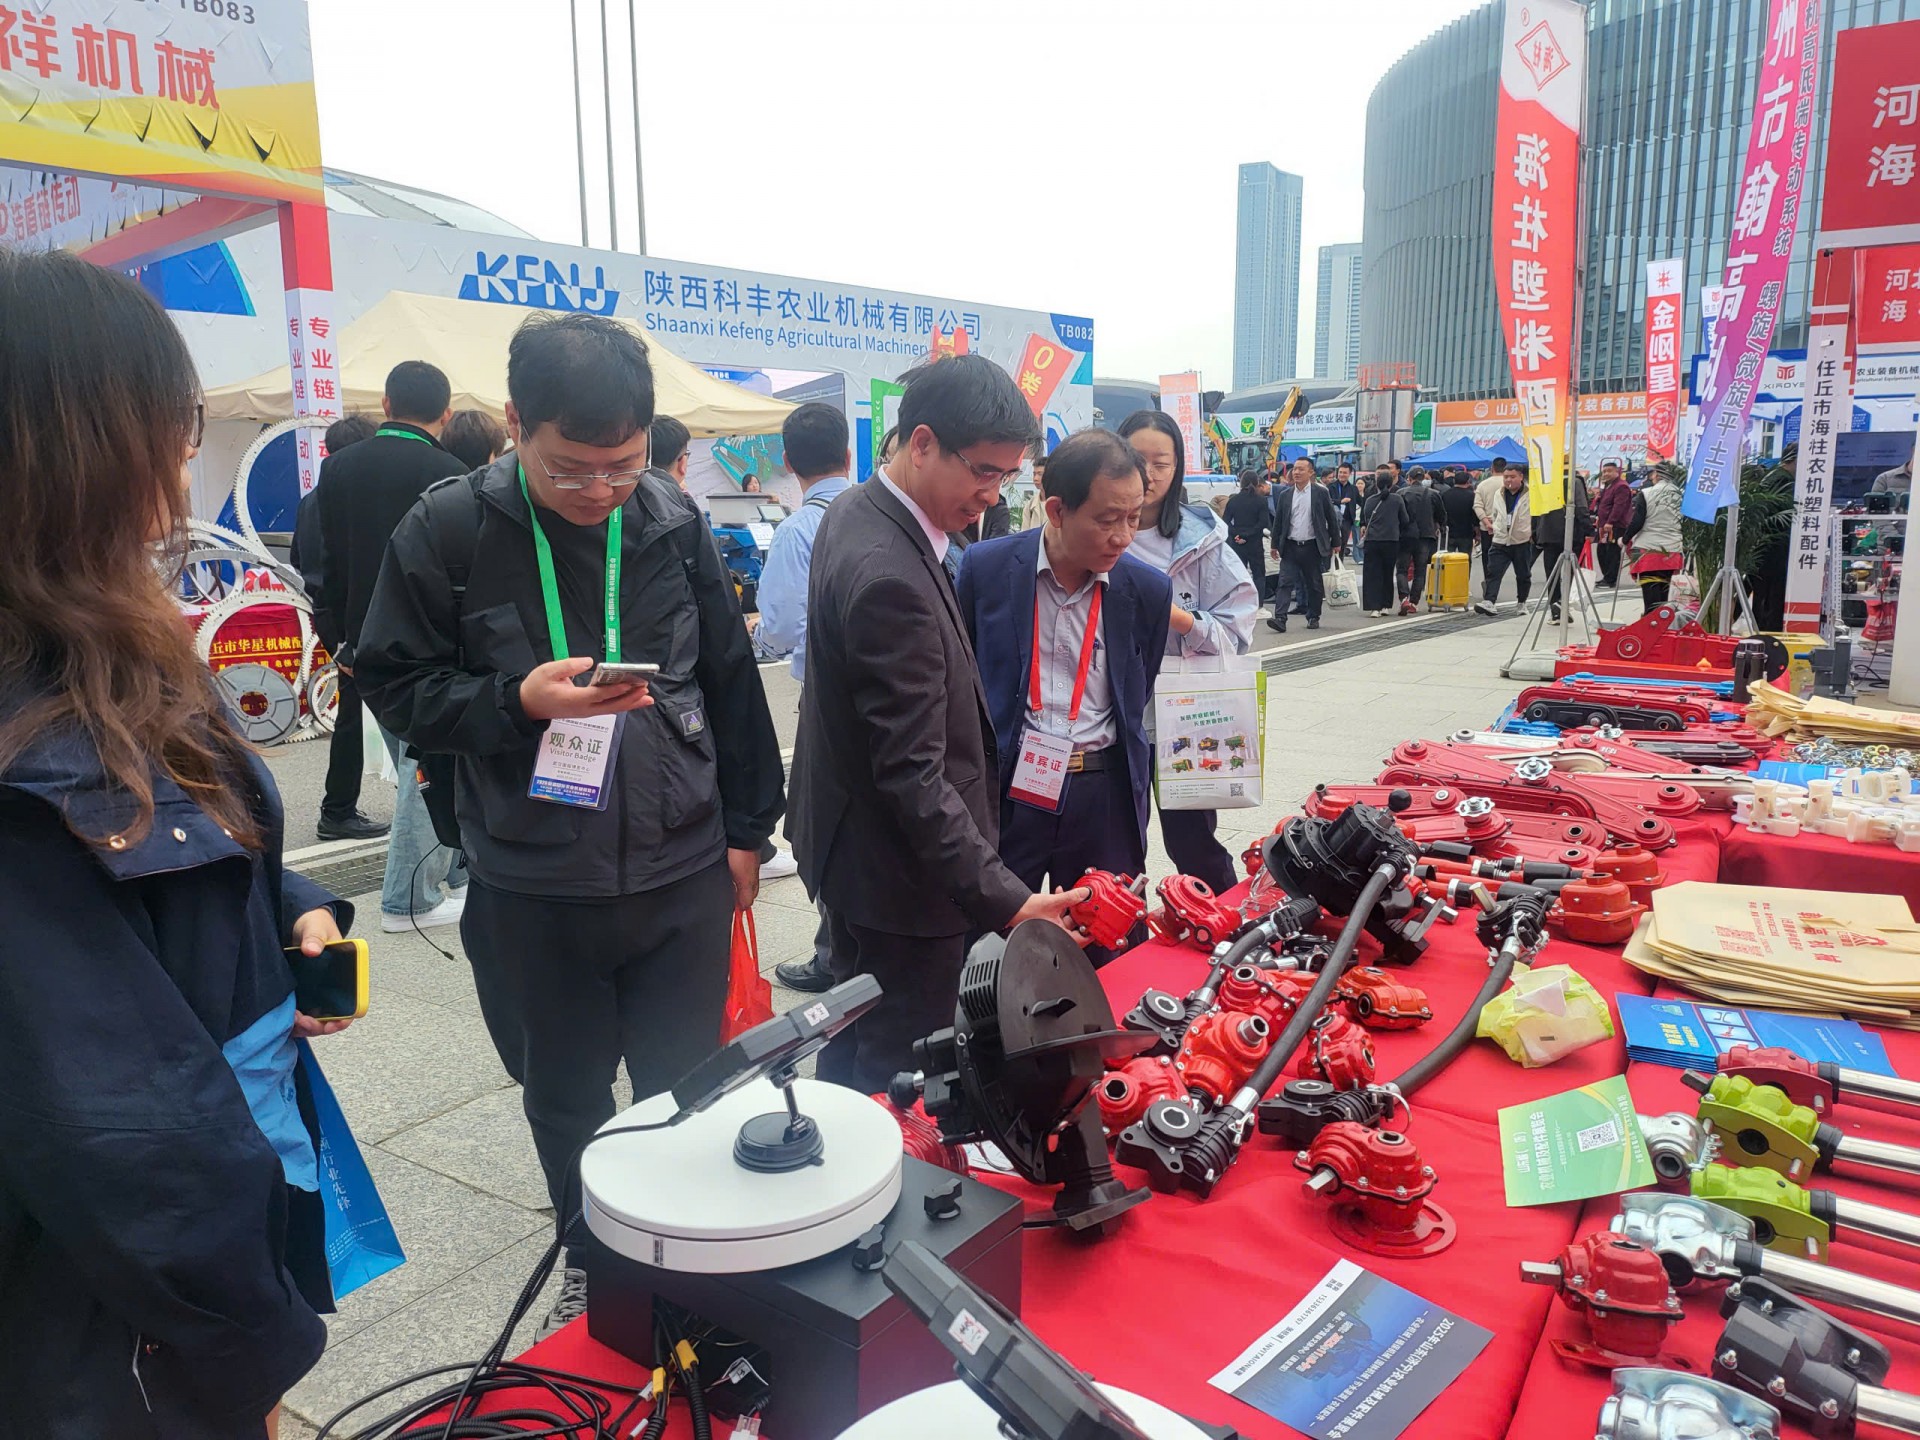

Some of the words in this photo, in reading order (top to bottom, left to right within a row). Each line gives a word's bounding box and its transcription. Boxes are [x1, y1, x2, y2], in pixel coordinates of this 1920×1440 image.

[476, 251, 606, 312] KFNJ
[644, 269, 980, 341] 陕西科丰农业机械有限公司
[645, 312, 714, 336] Shaanxi
[719, 320, 774, 347] Kefeng
[777, 326, 862, 351] Agricultural
[1059, 323, 1094, 341] TB082
[1797, 359, 1837, 570] 任丘市海柱农机塑料配件
[209, 636, 303, 655] 丘市华星机械配
[549, 732, 603, 755] 观众证
[550, 748, 573, 758] Visitor
[574, 753, 597, 763] Badge
[1023, 750, 1063, 773] 嘉宾证
[1035, 767, 1048, 775] VIP
